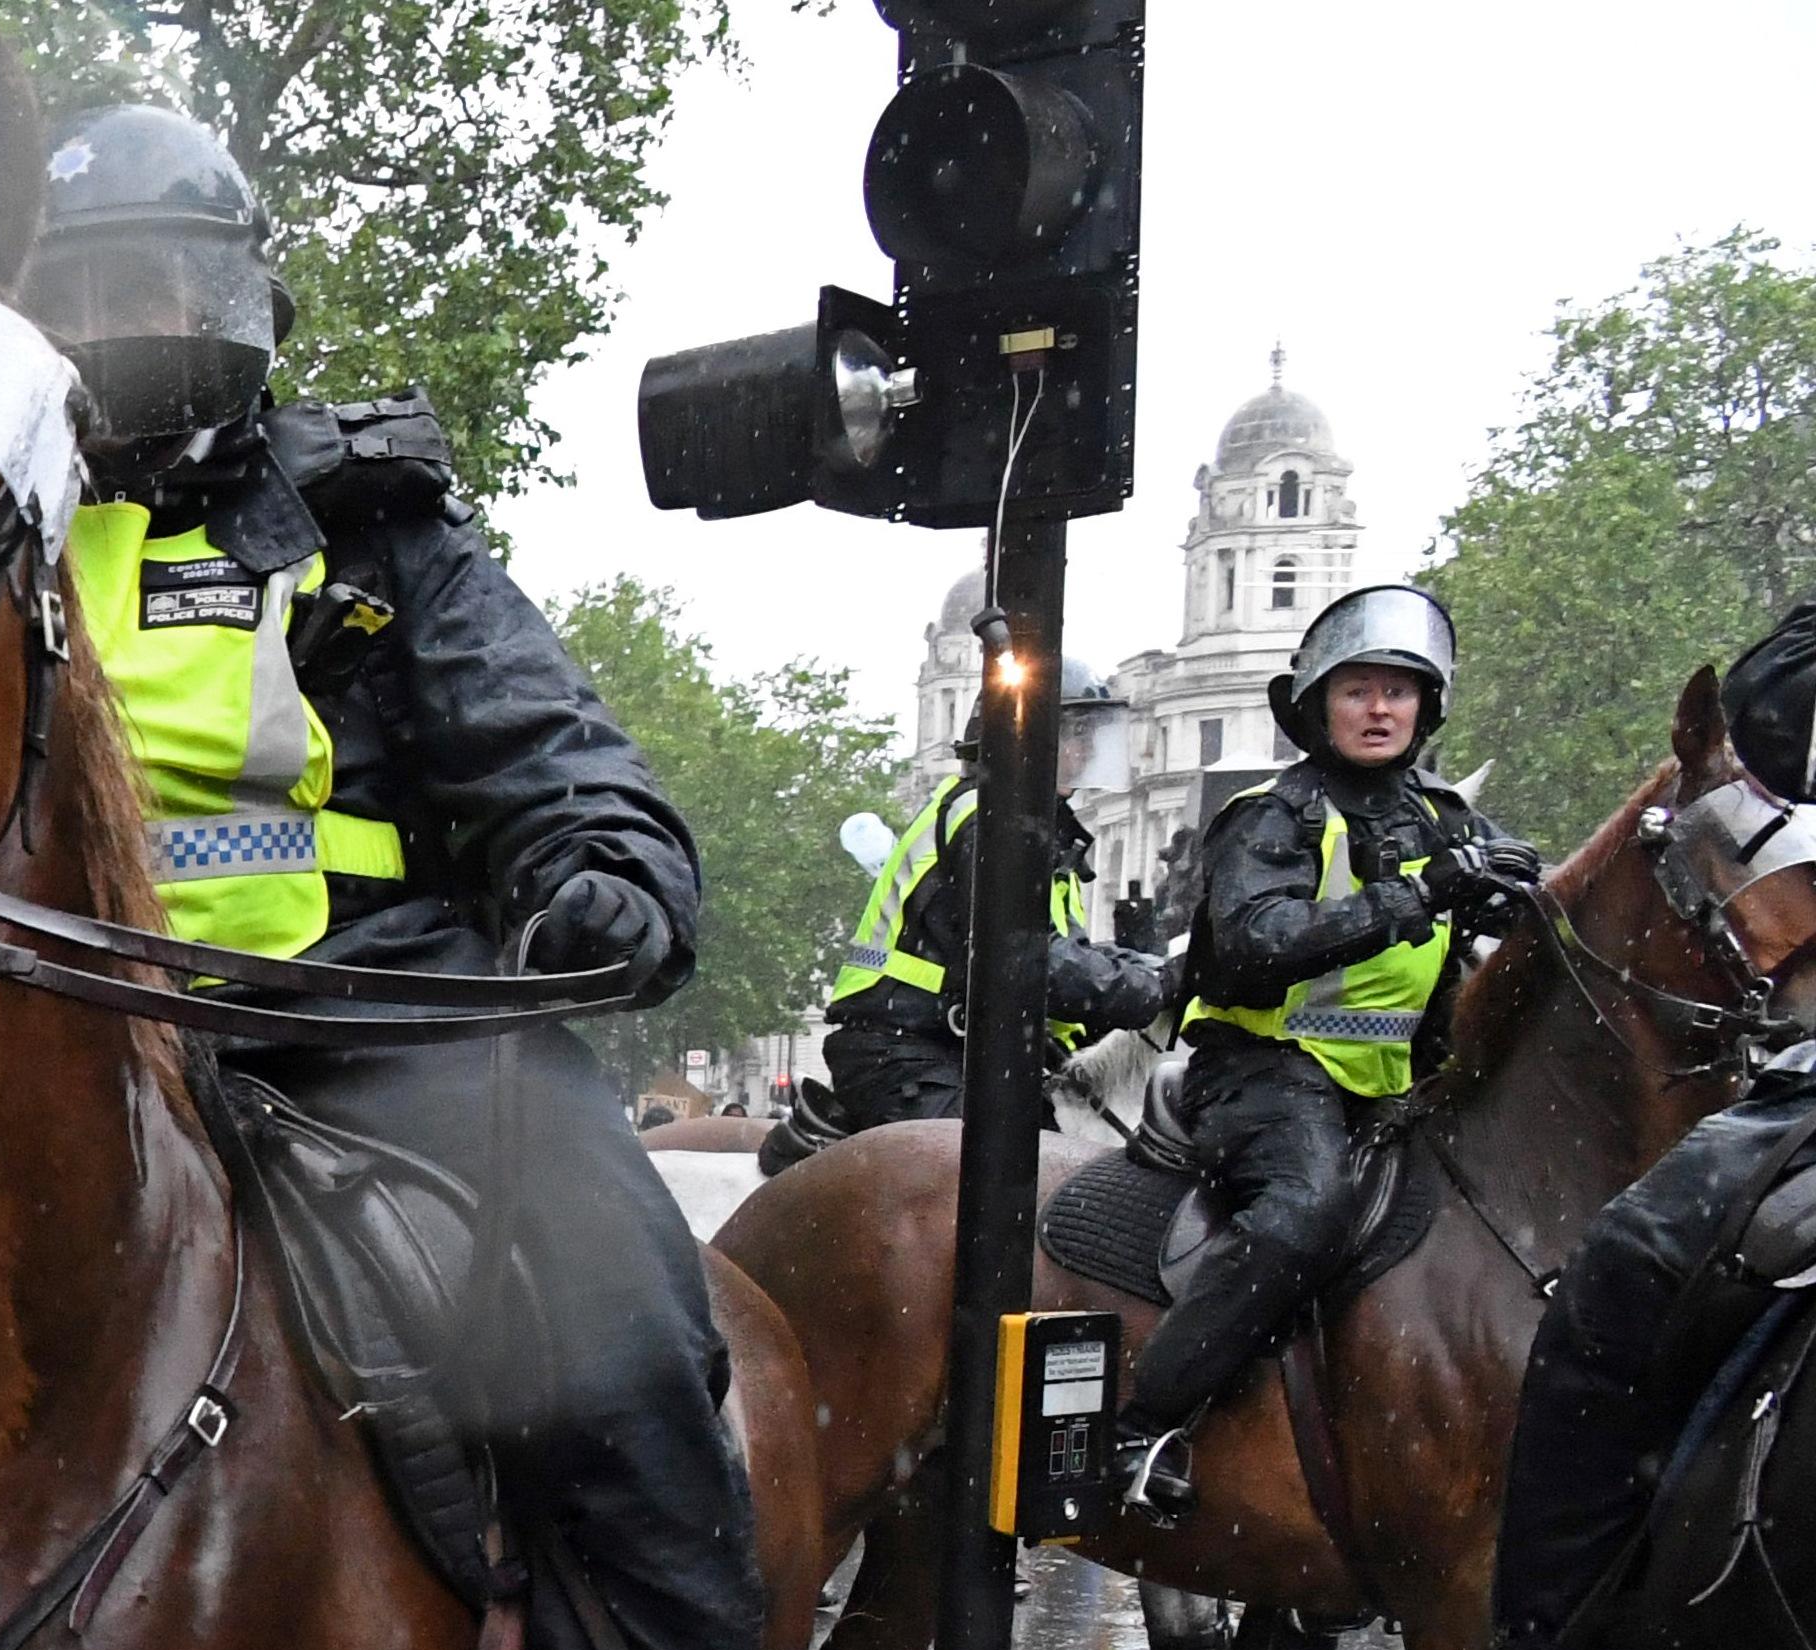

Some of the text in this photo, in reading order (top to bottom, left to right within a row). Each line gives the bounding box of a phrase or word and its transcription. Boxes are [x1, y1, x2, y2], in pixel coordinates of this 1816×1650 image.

[194, 594, 240, 605] POLICE
[147, 606, 254, 623] POLICE OFFICER
